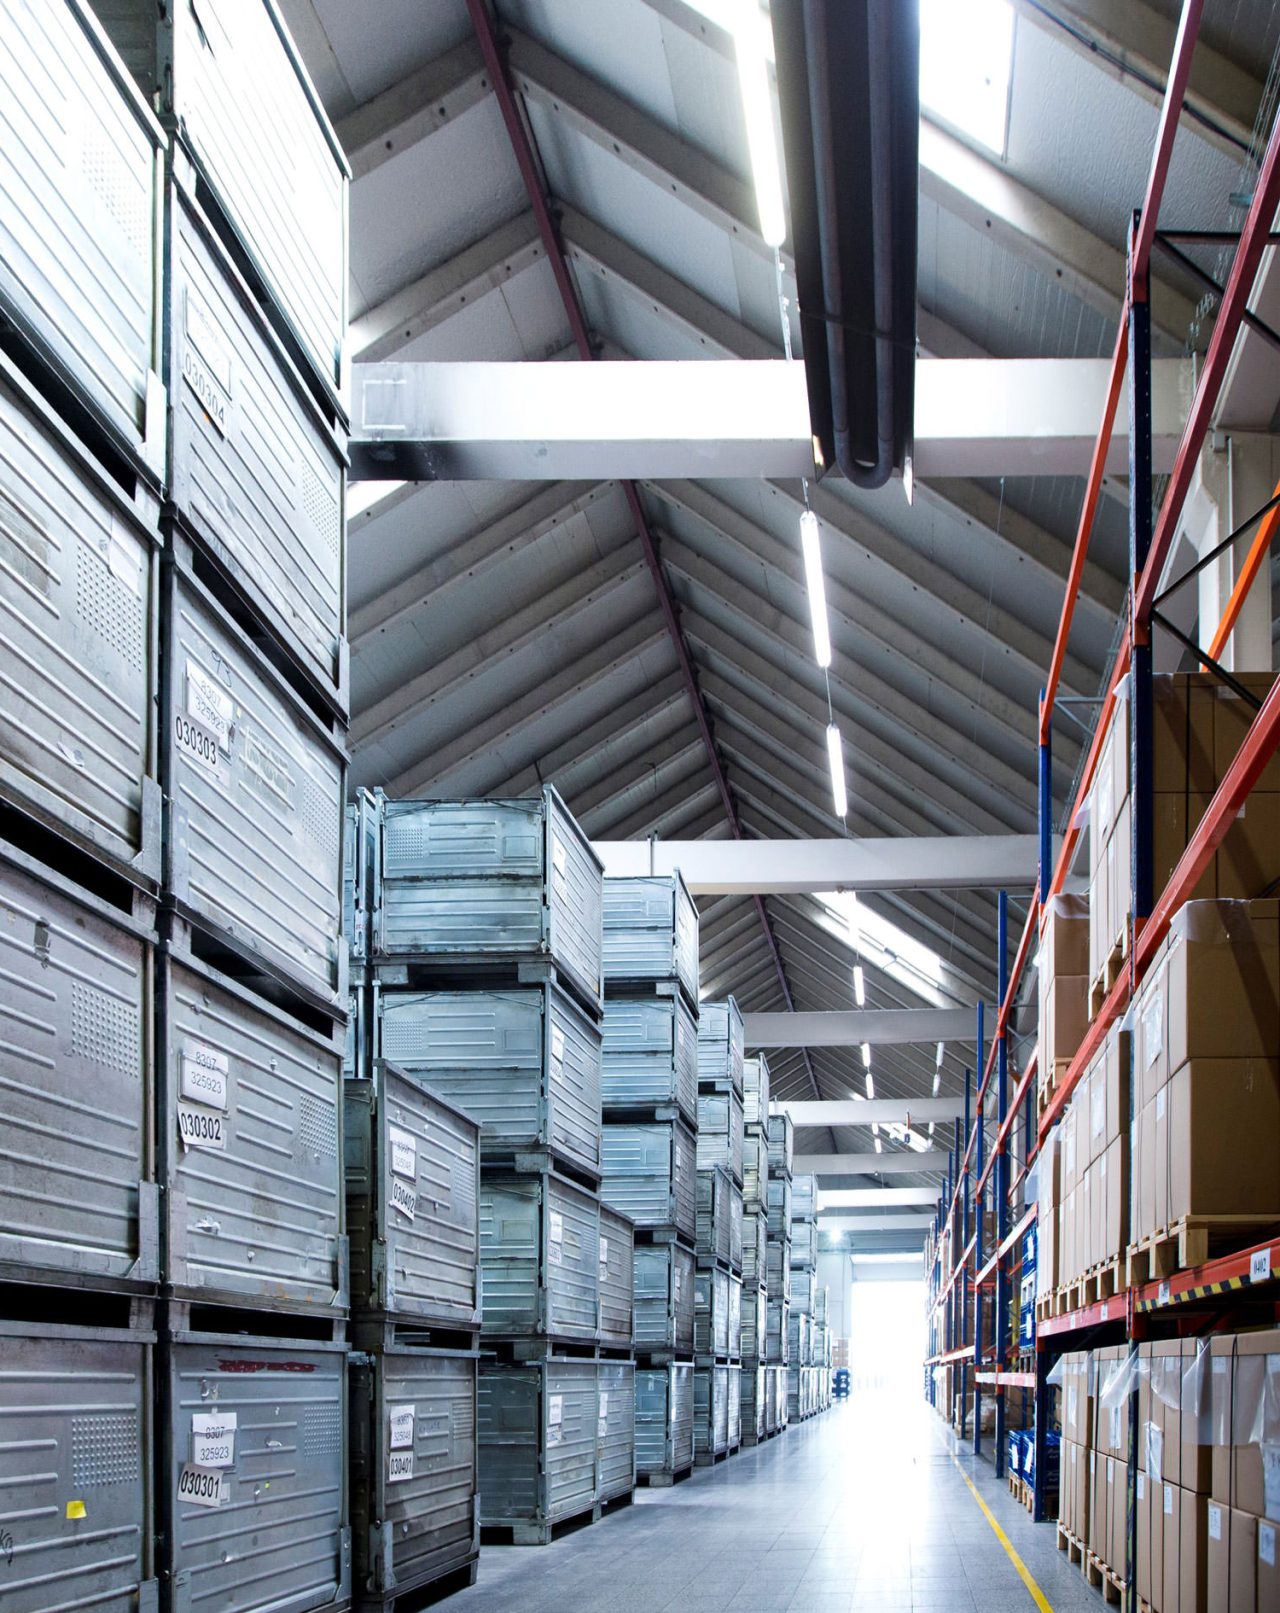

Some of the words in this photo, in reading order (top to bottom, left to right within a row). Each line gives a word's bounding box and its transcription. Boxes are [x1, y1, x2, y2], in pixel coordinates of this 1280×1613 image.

[185, 353, 225, 425] 030304
[176, 716, 216, 765] 030303
[191, 1072, 221, 1094] 325923
[181, 1113, 221, 1140] 030302
[393, 1183, 415, 1213] 030402
[200, 1446, 229, 1461] 325923
[391, 1457, 411, 1475] 030401
[181, 1470, 219, 1499] 030301
